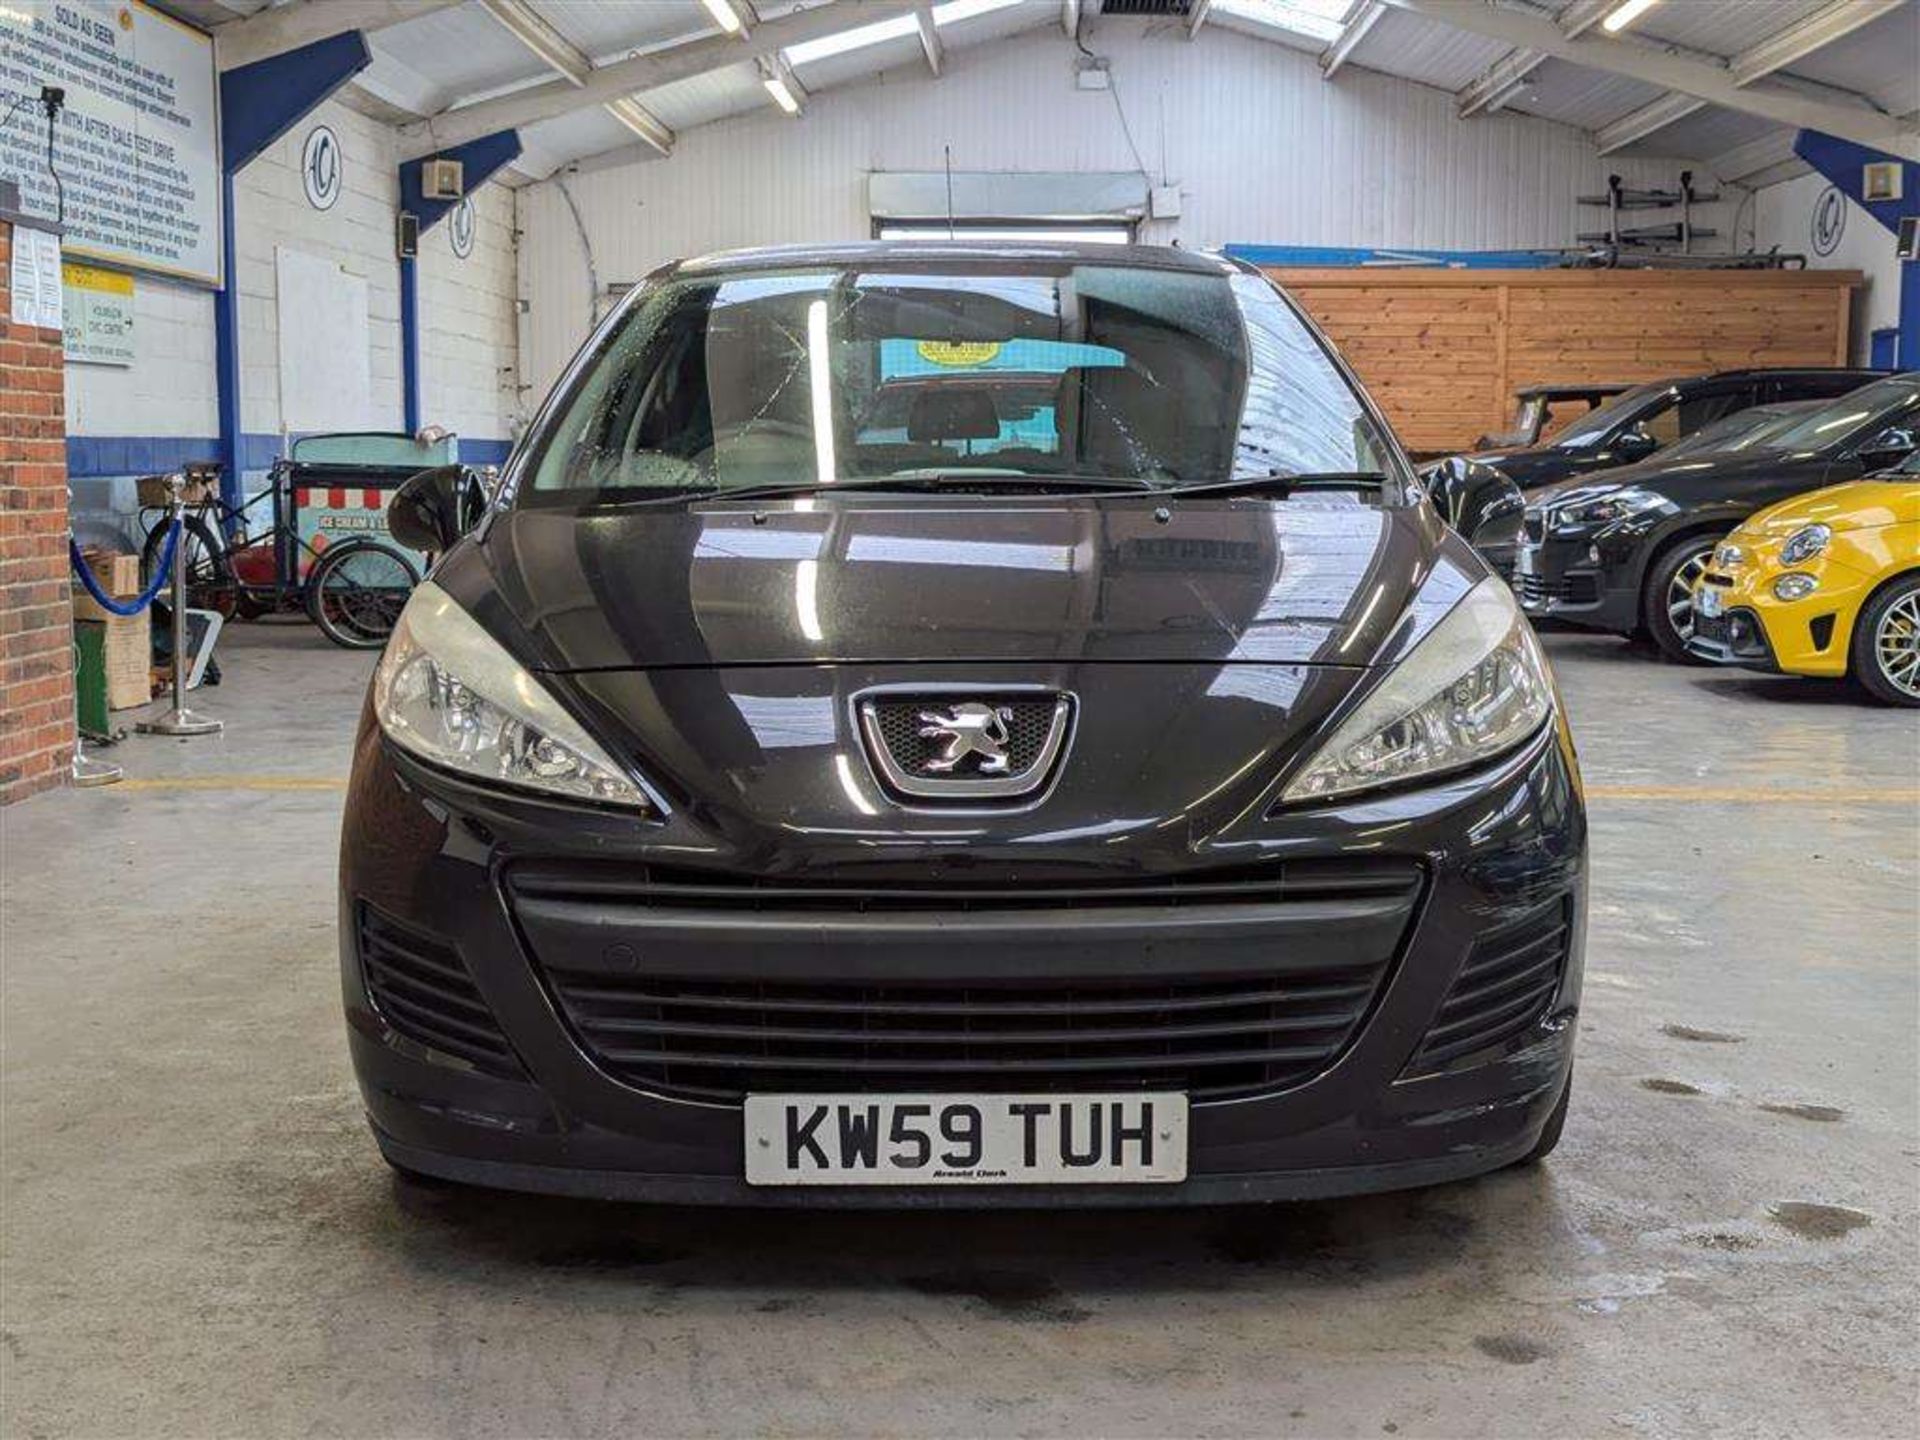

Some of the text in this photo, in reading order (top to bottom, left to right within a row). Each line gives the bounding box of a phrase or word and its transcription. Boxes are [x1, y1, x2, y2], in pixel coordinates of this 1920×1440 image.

[55, 5, 115, 47] SOLD AS SEEN
[84, 118, 109, 141] AFTER
[111, 127, 132, 149] SALE
[786, 1102, 1154, 1170] KW59 TUH
